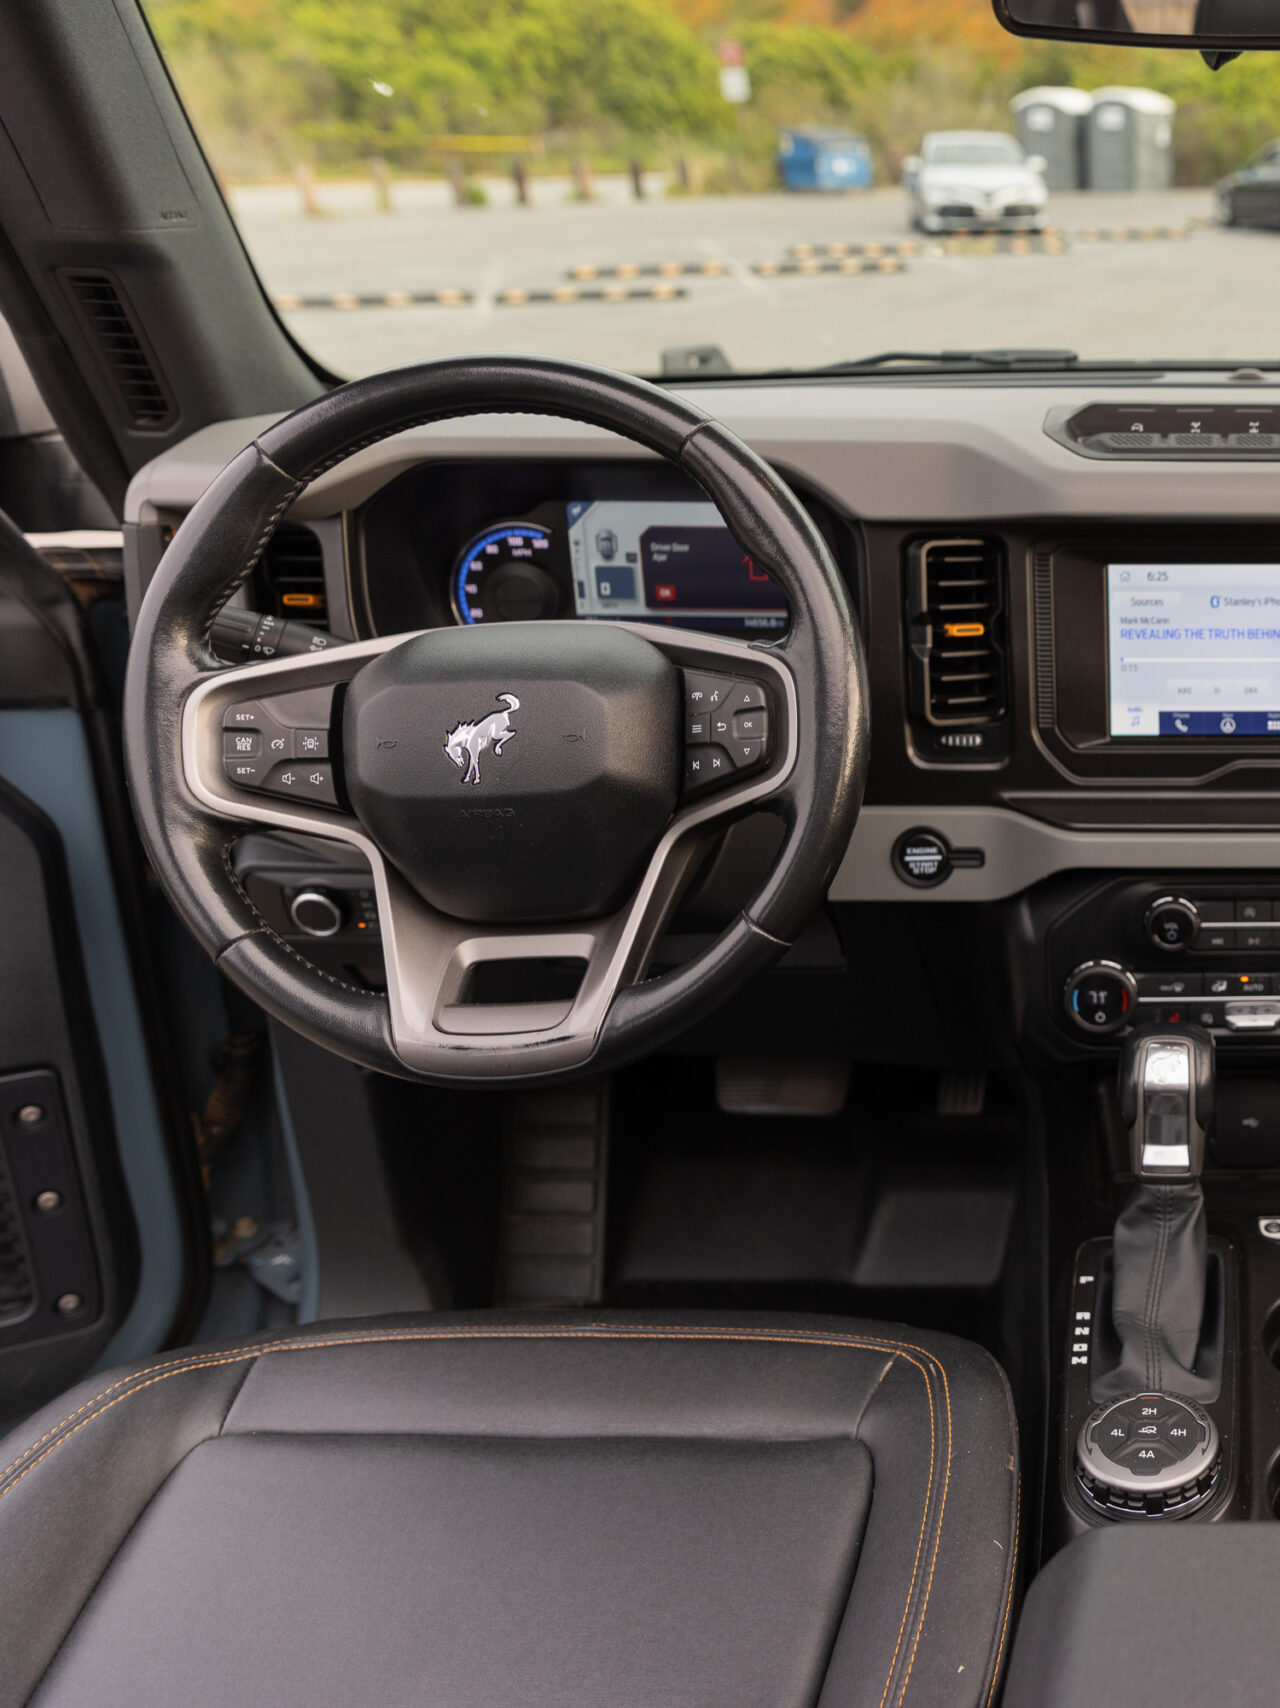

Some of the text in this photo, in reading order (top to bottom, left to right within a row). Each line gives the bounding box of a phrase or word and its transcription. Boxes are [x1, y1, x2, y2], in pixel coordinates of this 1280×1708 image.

[1147, 570, 1169, 581] 6:25
[1130, 597, 1165, 607] Sources
[1120, 628, 1182, 640] REVEALING
[1184, 628, 1205, 640] THE
[1208, 628, 1245, 640] TRUTH
[1074, 1326, 1090, 1336] N
[1071, 1355, 1088, 1365] M
[1141, 1407, 1157, 1415] 2H
[1110, 1428, 1187, 1437] 4L 4H
[1138, 1450, 1155, 1459] 4A
